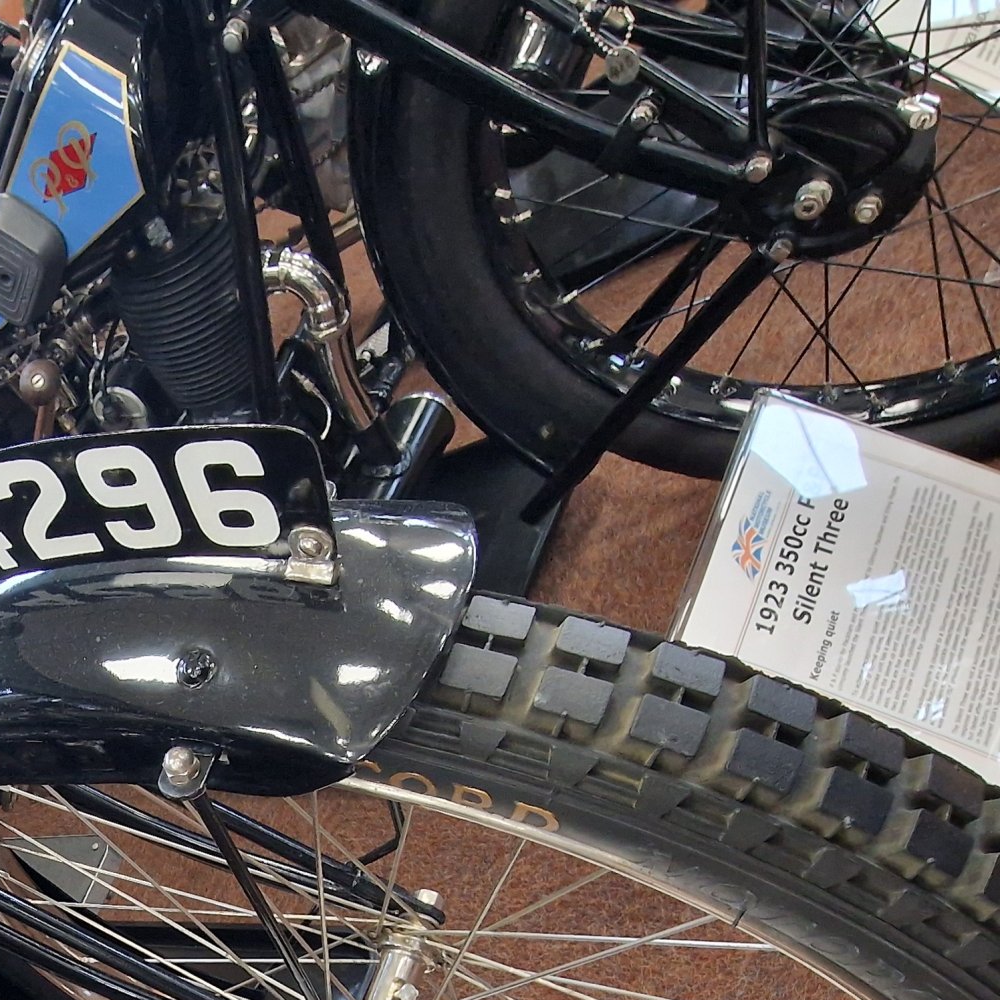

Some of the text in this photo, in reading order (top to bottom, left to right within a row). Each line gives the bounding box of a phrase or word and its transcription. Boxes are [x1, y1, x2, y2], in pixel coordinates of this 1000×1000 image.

[755, 580, 788, 634] 1923
[775, 514, 810, 575] 350cc
[792, 498, 848, 624] Silent Three
[809, 610, 839, 680] Keeping quiet
